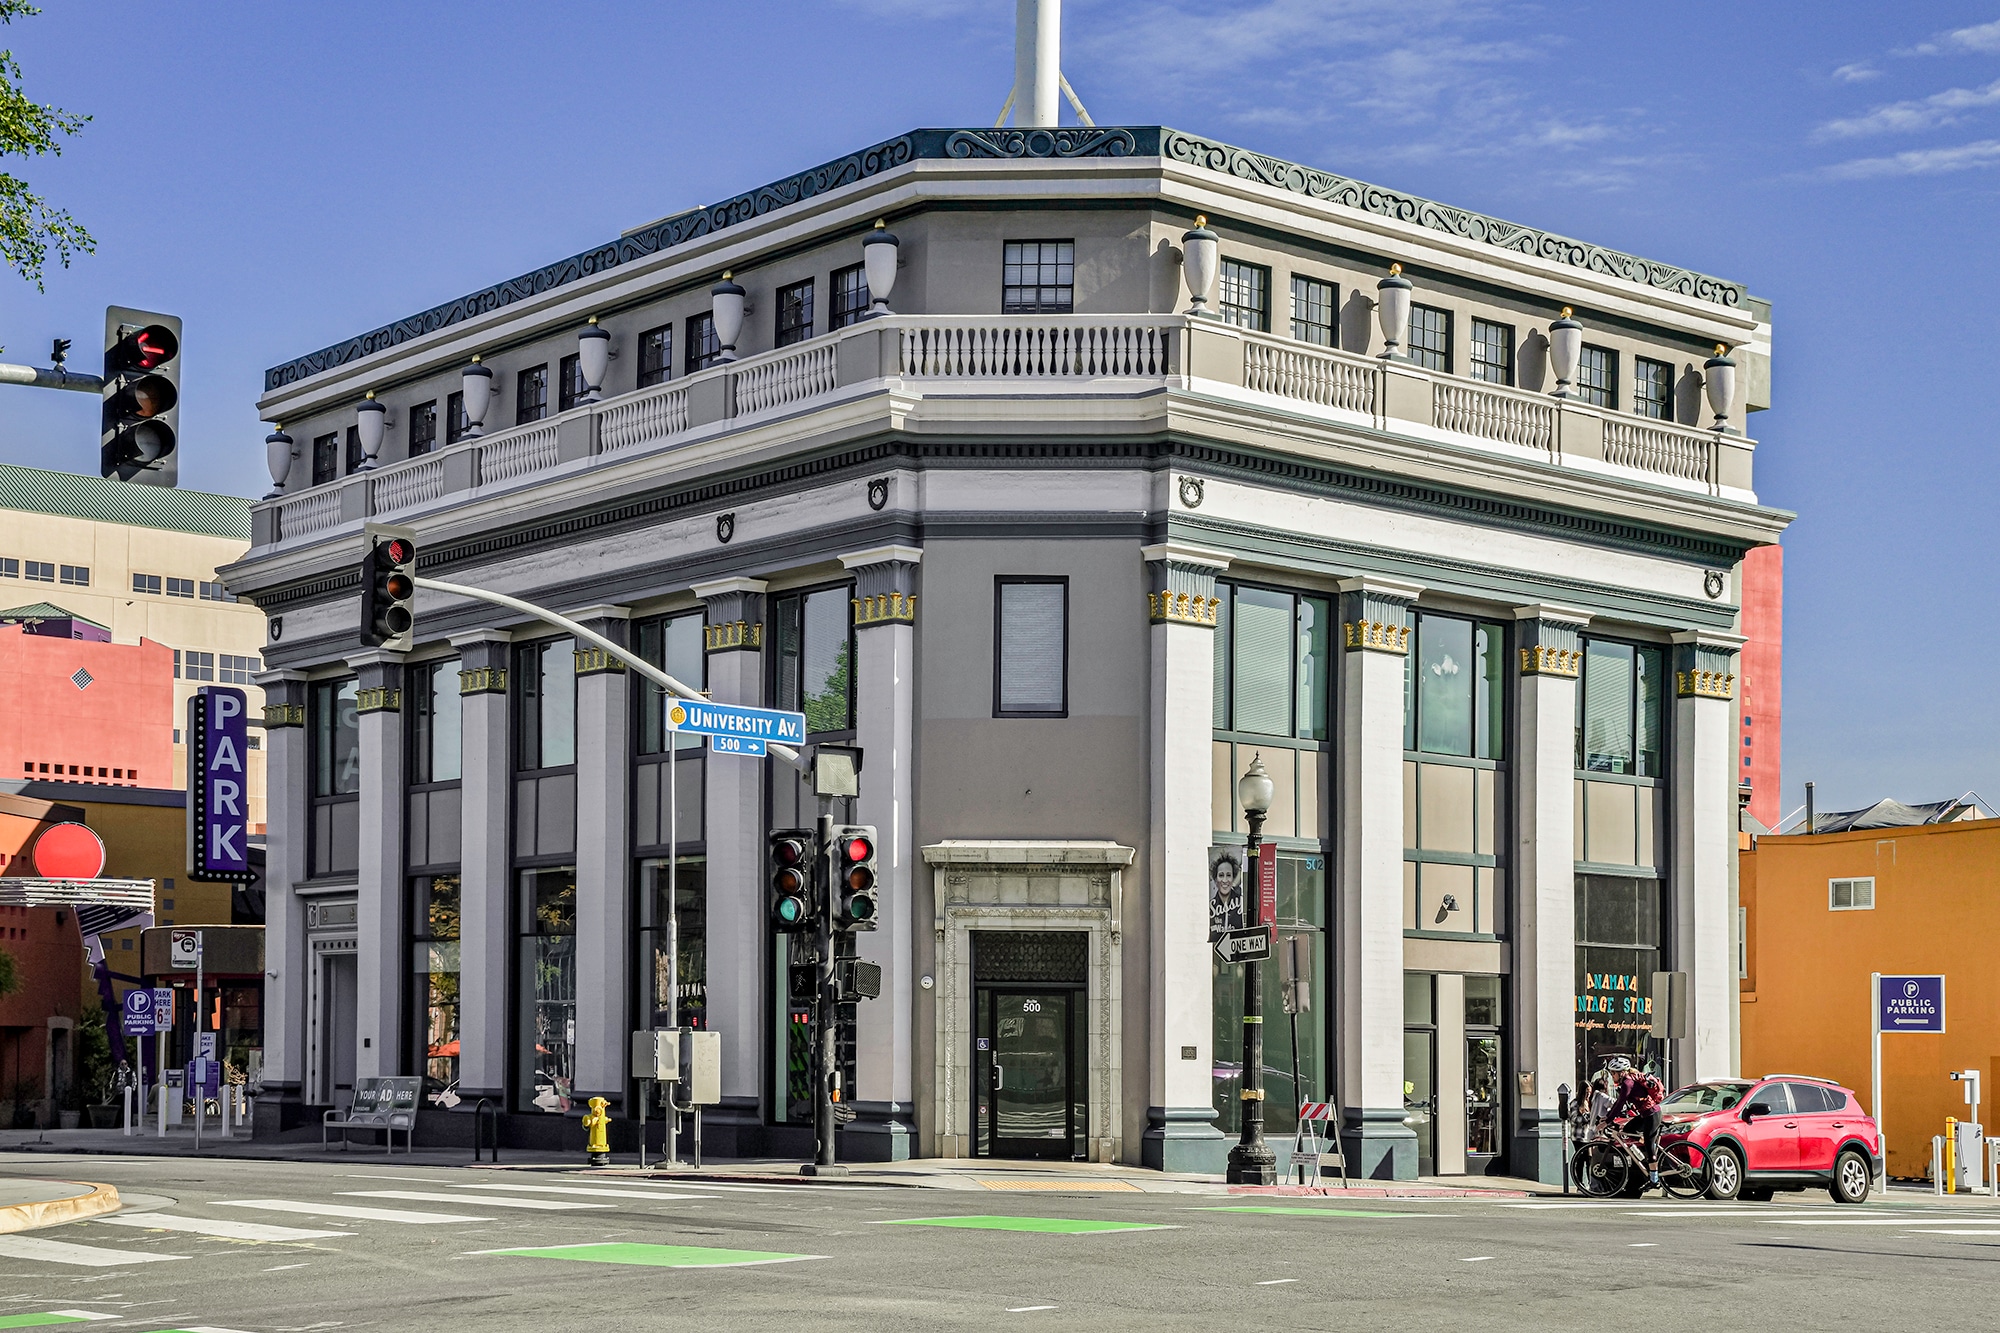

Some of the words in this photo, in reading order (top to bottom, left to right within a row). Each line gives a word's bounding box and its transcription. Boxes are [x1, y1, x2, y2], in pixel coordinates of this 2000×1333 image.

[690, 707, 772, 735] UNIVERSITY
[720, 738, 740, 751] 500
[210, 694, 242, 861] PARK
[1305, 857, 1324, 871] 502
[1209, 895, 1244, 919] Sassy
[1230, 939, 1246, 952] ONE
[1248, 937, 1264, 950] WAY
[1587, 972, 1637, 991] ANAMAYA
[155, 990, 171, 998] PARK
[155, 999, 171, 1007] HERE
[1023, 1003, 1041, 1012] 500
[1574, 995, 1614, 1013] INTAGE
[1623, 997, 1652, 1015] STOR
[1887, 1006, 1935, 1014] PARKING
[360, 1090, 377, 1100] YOUR
[380, 1089, 393, 1102] AD
[396, 1090, 413, 1100] HERE
